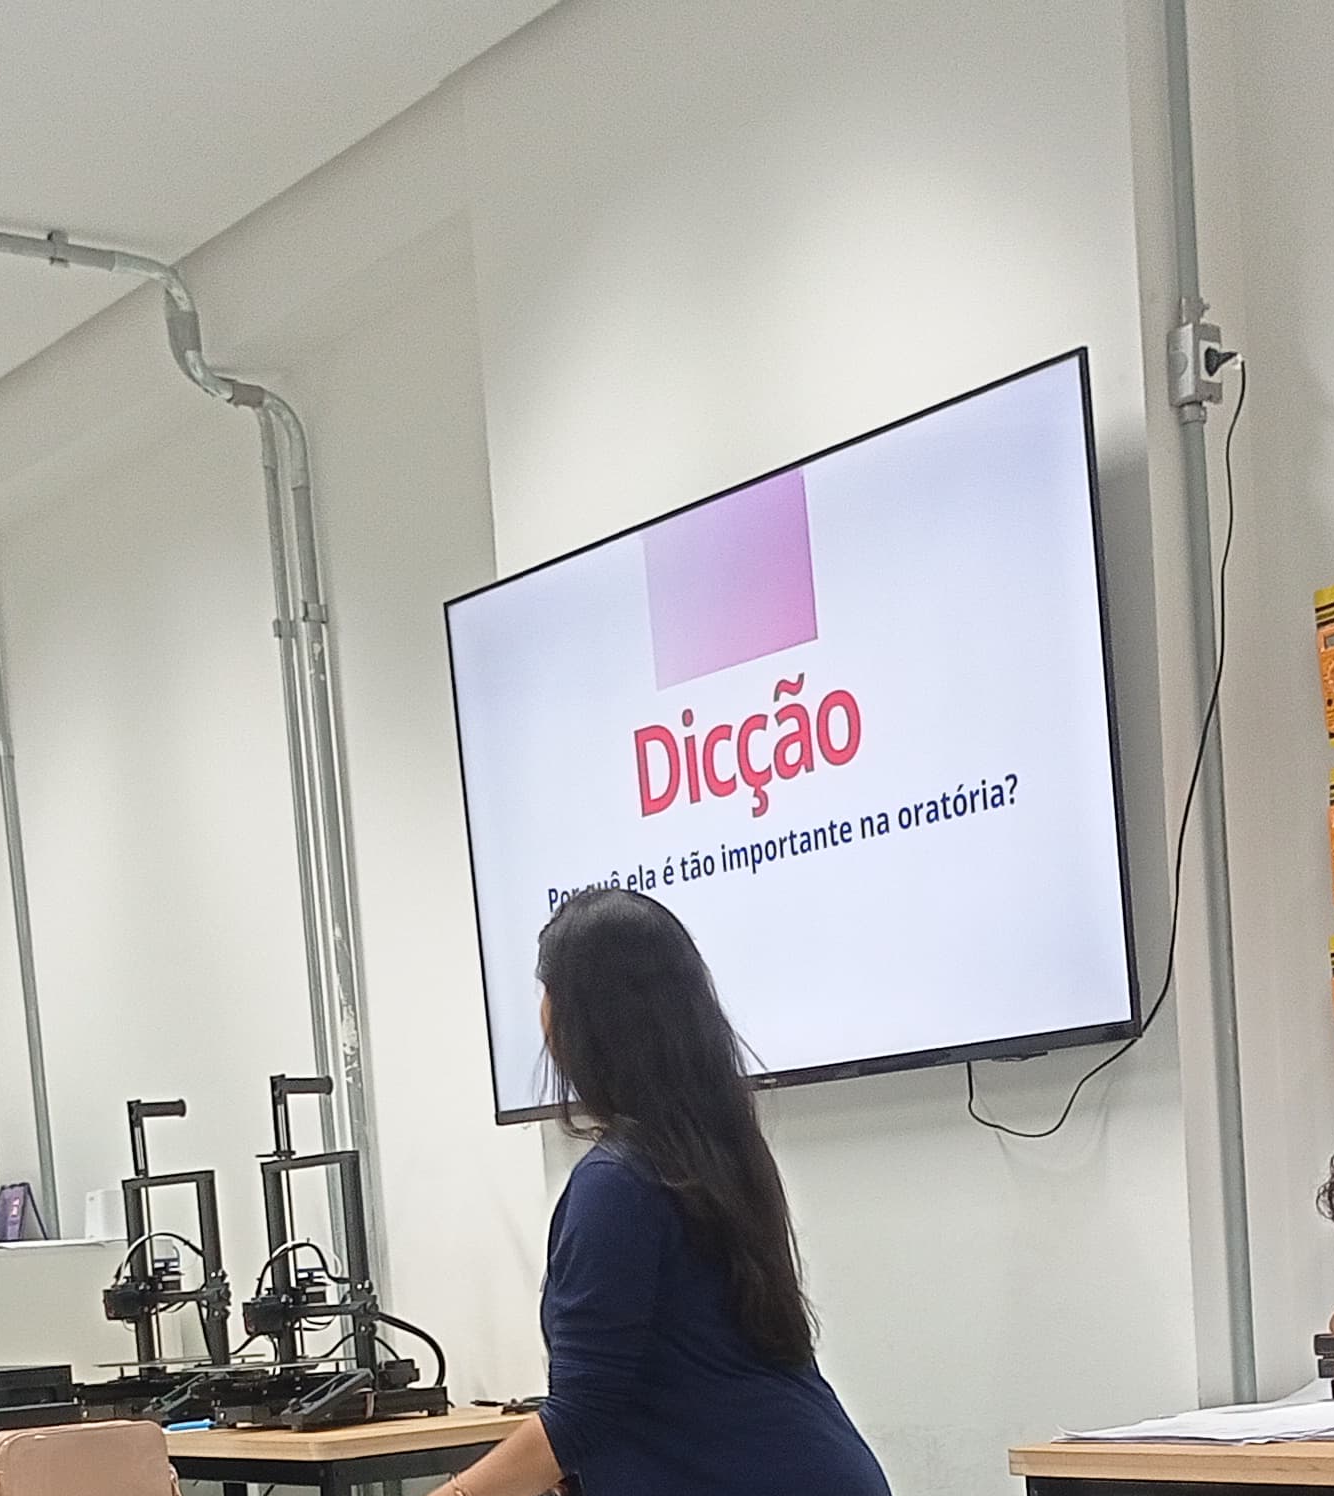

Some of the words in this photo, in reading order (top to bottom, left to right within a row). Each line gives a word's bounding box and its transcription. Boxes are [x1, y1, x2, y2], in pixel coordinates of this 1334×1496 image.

[634, 673, 862, 819] Dicção
[626, 864, 657, 891] ela
[662, 855, 675, 886] é
[680, 849, 715, 881] tão
[720, 818, 854, 875] importante
[860, 811, 890, 841] na
[897, 772, 1020, 831] oratória?
